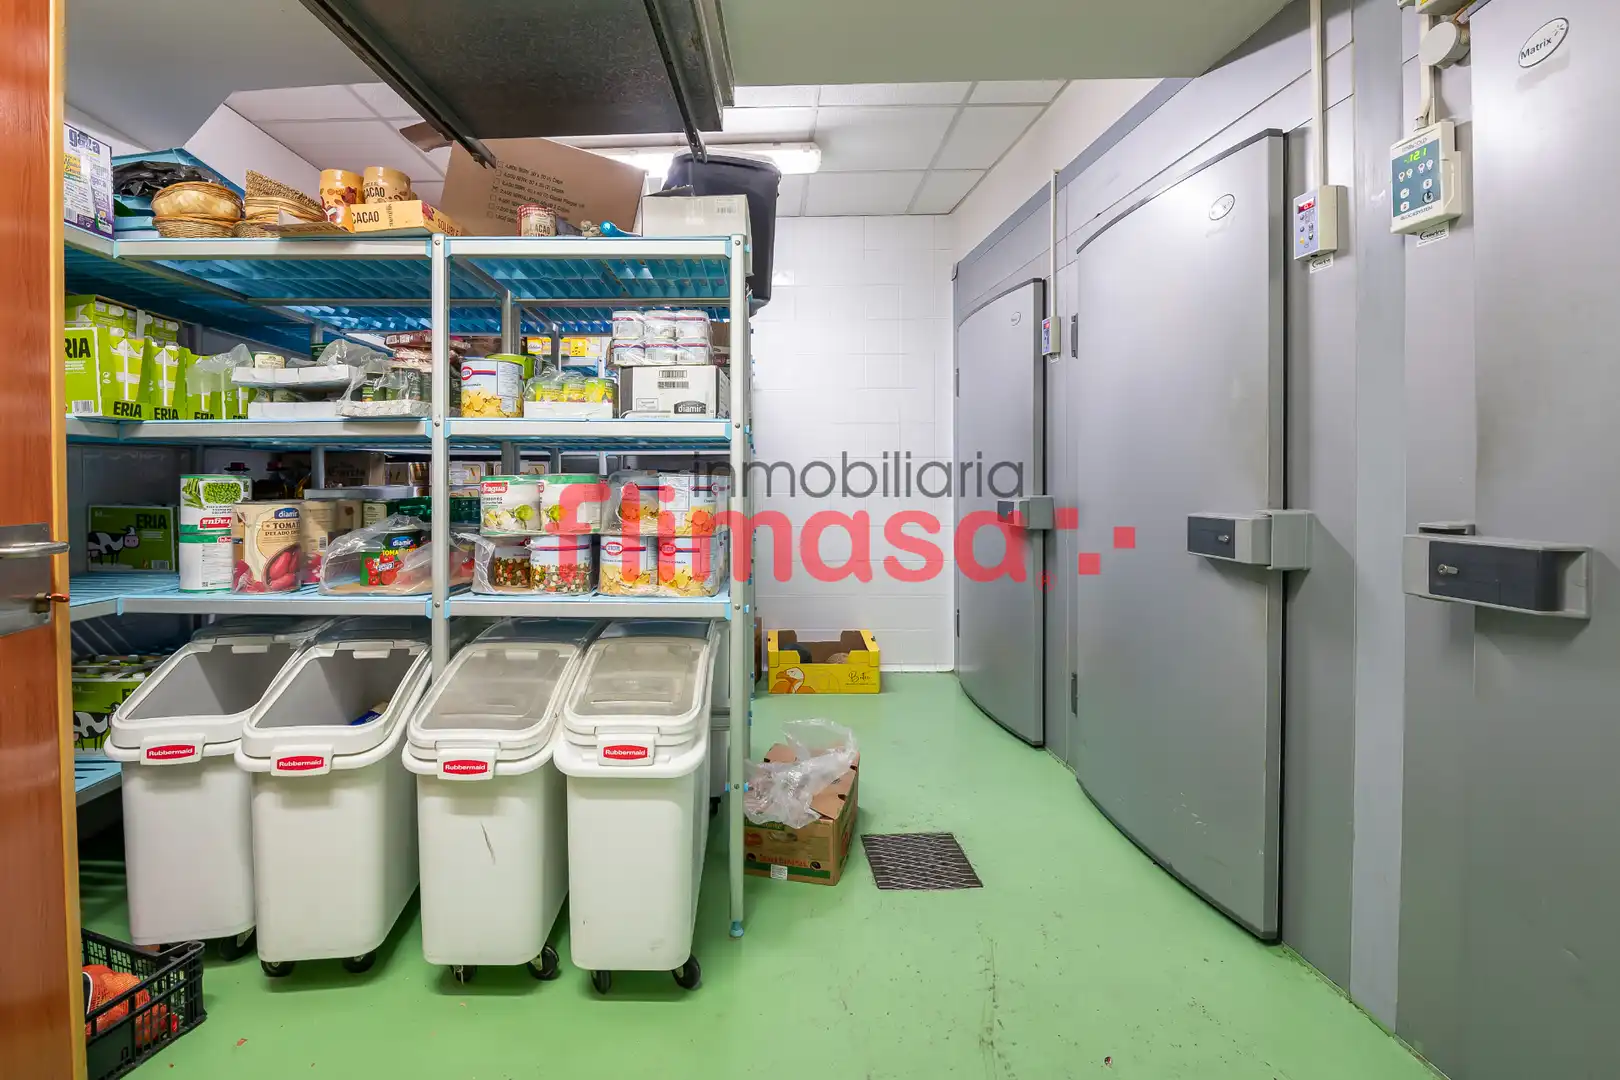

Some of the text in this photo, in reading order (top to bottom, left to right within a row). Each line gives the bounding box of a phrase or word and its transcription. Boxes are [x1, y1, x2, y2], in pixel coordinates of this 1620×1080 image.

[1521, 38, 1551, 60] Matrix
[351, 211, 380, 224] CACAO
[65, 337, 92, 360] RIA
[113, 401, 142, 418] ERIA
[678, 401, 703, 413] diamir
[154, 407, 179, 420] ERIA
[278, 510, 298, 518] diamir
[135, 513, 168, 529] ERIA
[272, 521, 300, 529] TOMAT
[392, 538, 412, 547] diamir
[148, 747, 193, 757] Rubbermaid
[604, 748, 646, 756] Rubbermaid
[278, 759, 322, 768] Rubbermaid
[444, 764, 486, 772] Rubbermaid
